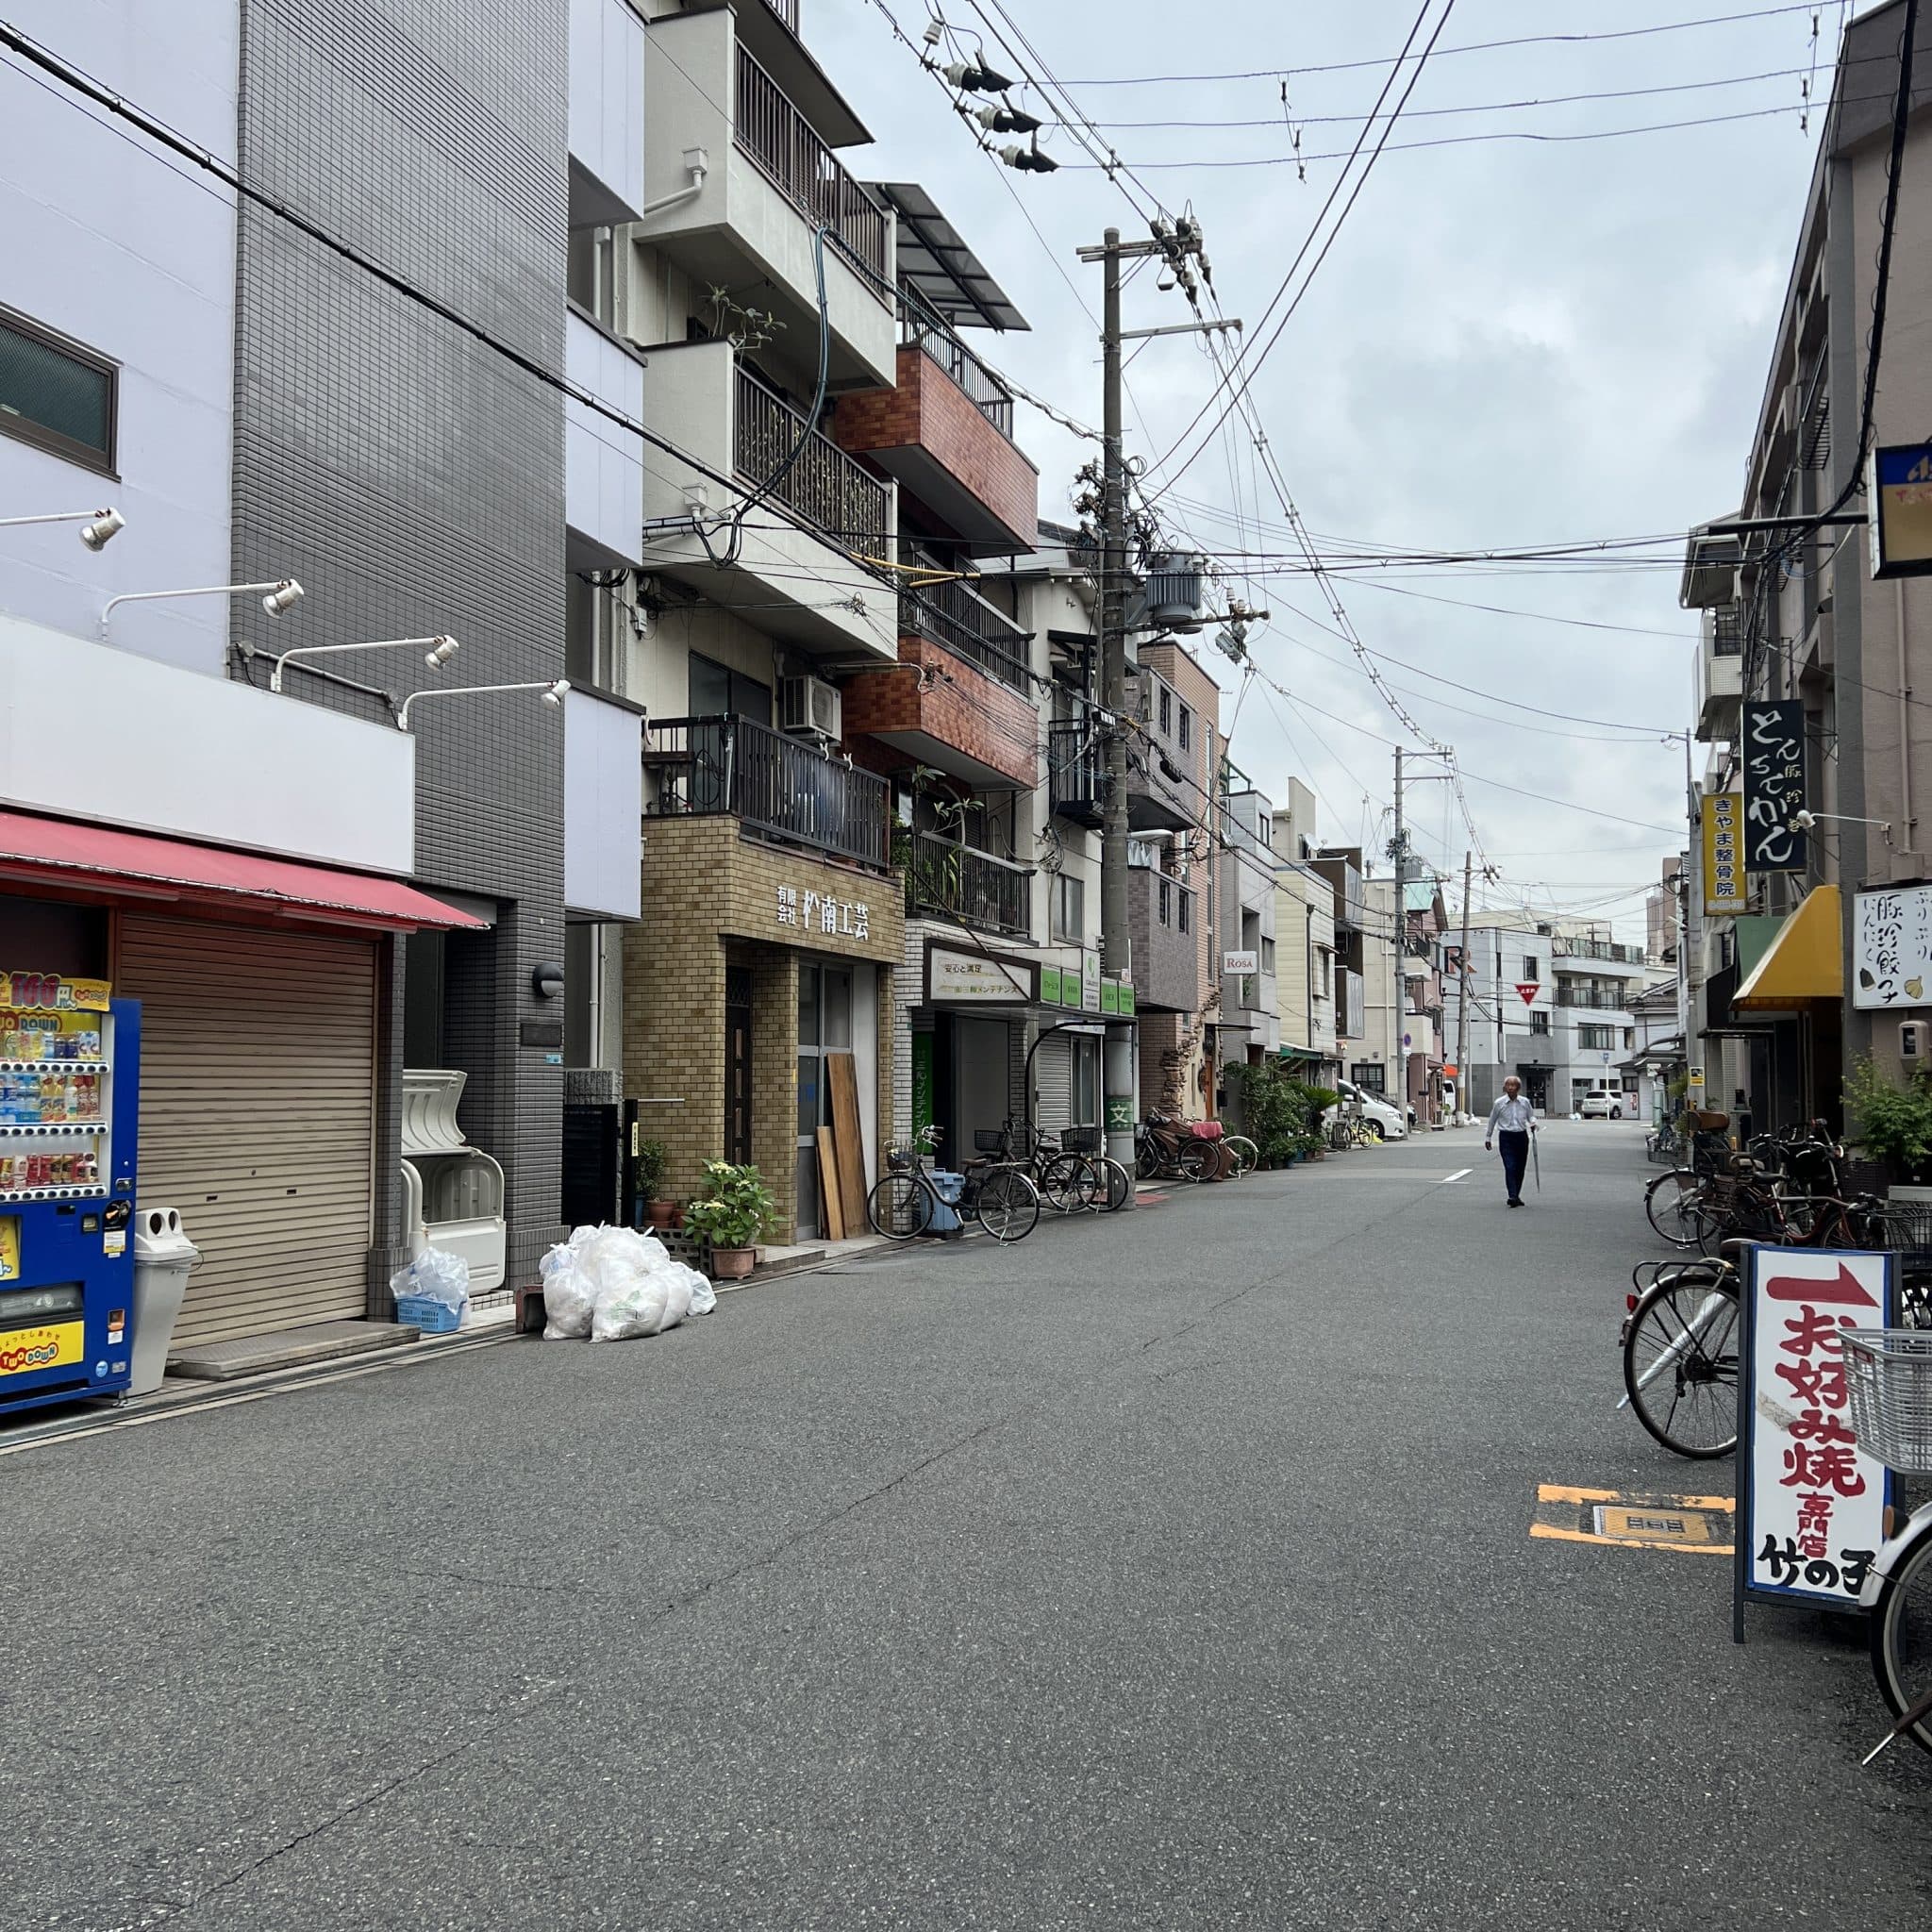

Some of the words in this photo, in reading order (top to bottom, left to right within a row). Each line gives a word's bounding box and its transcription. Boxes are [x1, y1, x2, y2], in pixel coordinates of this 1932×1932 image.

[1715, 799, 1735, 896] きやま整骨院
[1110, 1105, 1129, 1124] 文
[2, 1351, 25, 1367] TWO
[26, 1345, 57, 1363] DOWN
[1774, 1304, 1867, 1498] お好み焼
[1757, 1533, 1875, 1595] 竹の子
